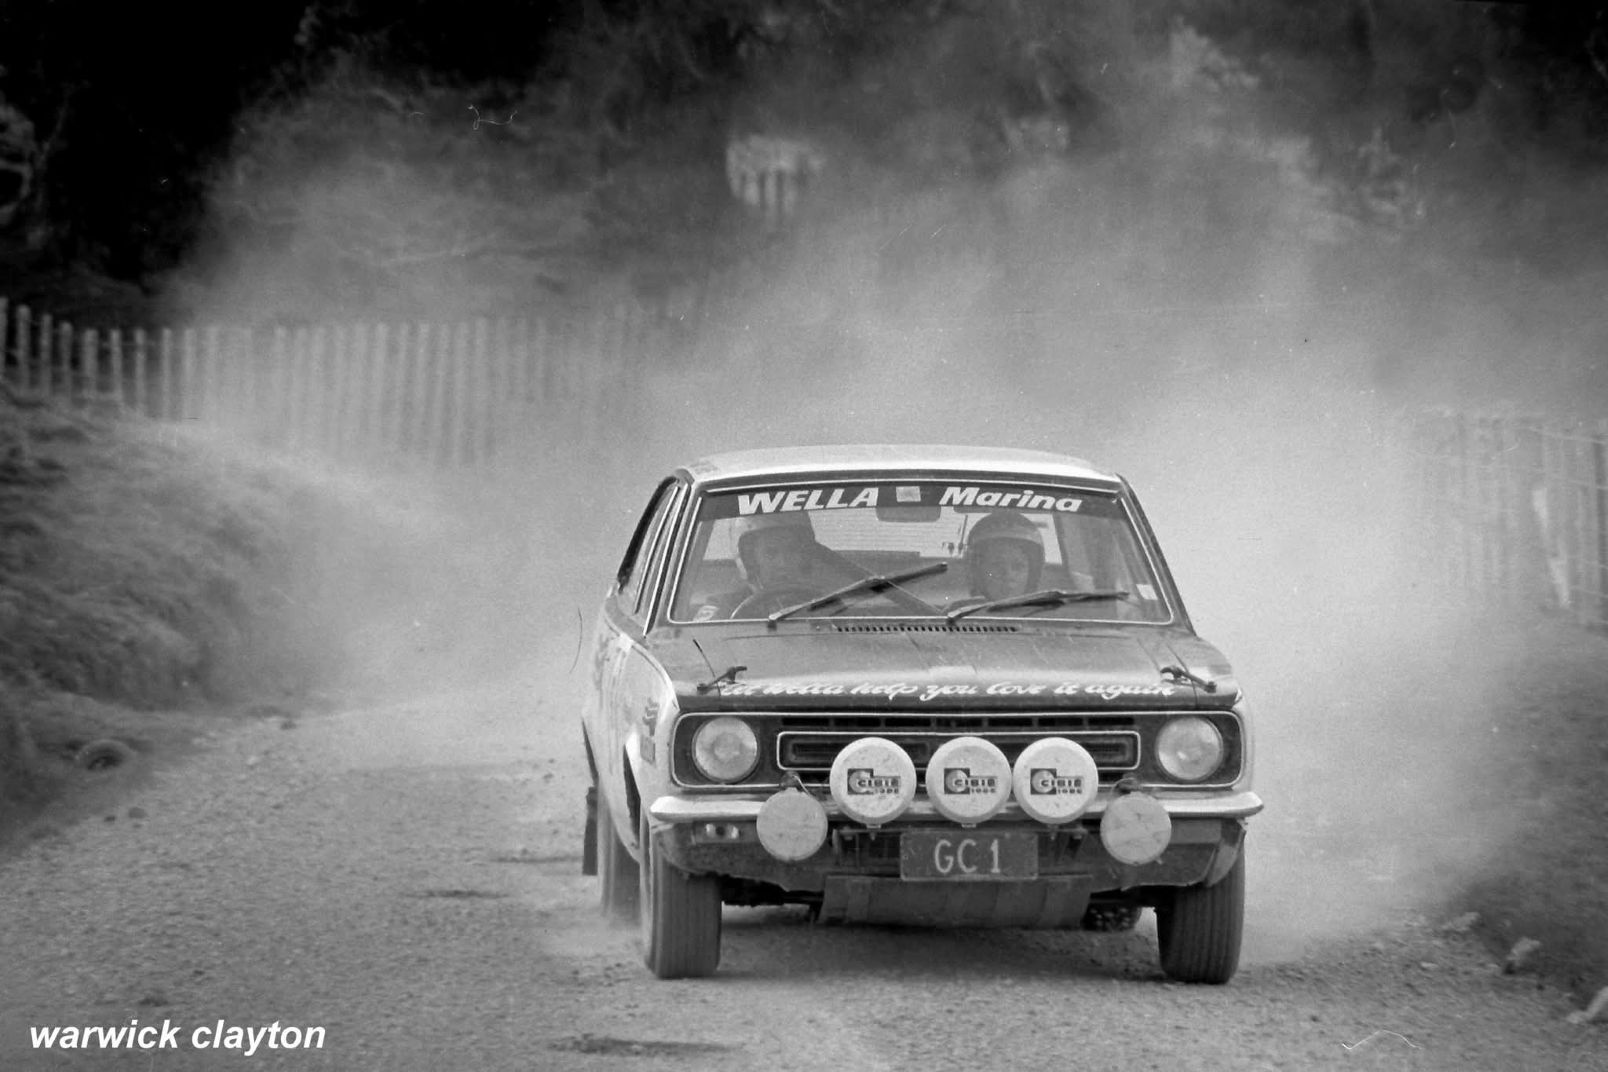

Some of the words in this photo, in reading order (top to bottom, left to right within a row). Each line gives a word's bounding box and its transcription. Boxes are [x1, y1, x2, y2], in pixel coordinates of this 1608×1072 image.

[737, 487, 880, 515] WELLA
[939, 486, 1083, 513] Marina
[918, 683, 979, 701] you
[986, 680, 1047, 695] love
[1053, 681, 1080, 695] it
